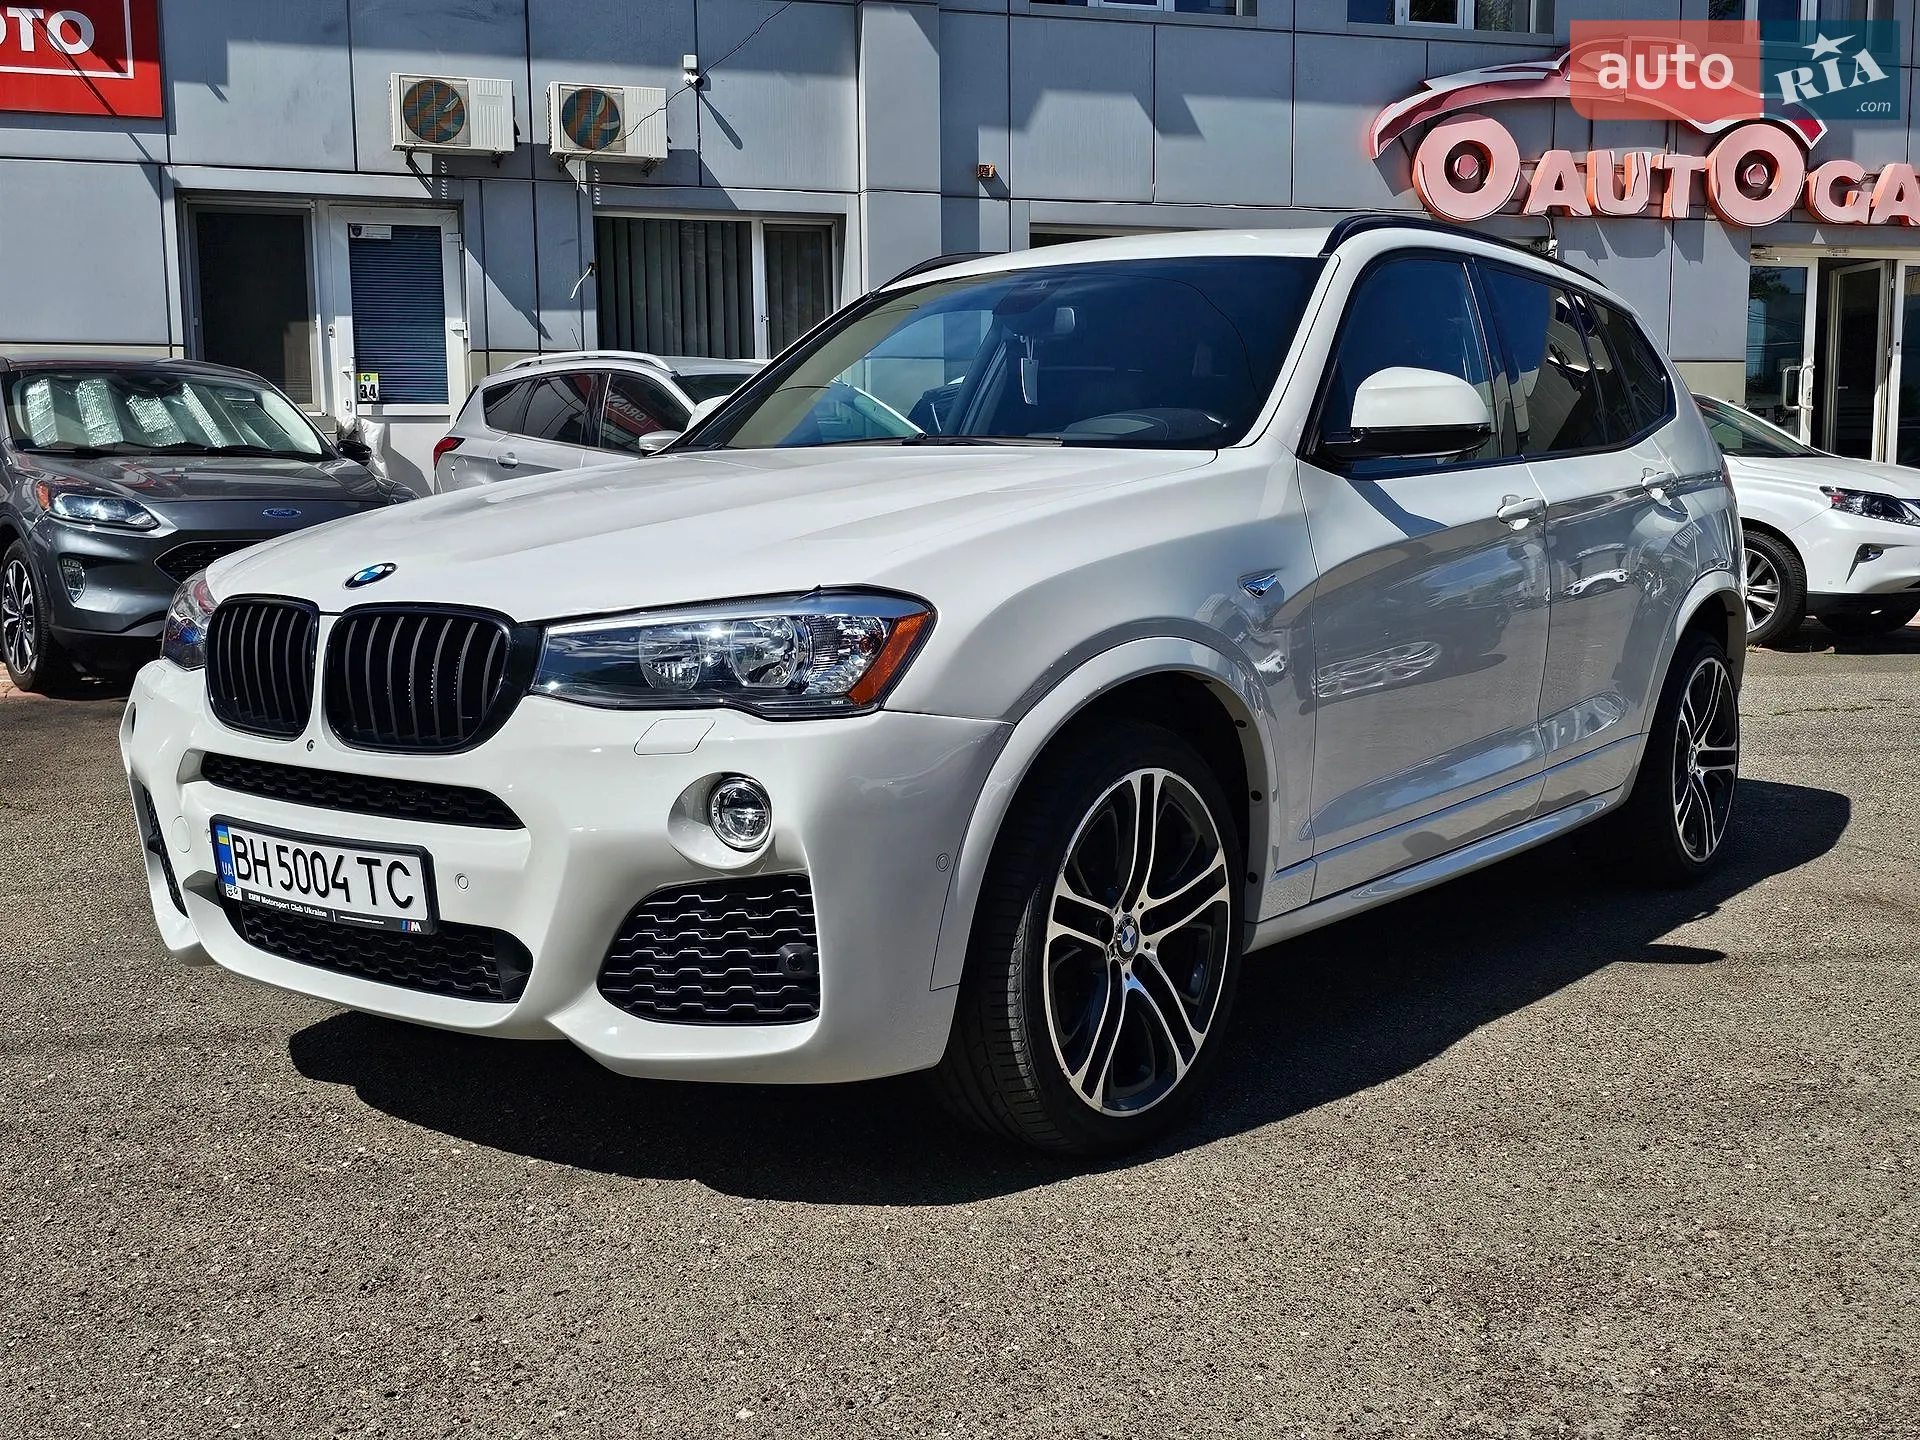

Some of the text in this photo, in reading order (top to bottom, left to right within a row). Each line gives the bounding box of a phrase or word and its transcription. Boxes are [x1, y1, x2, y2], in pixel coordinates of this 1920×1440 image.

[0, 6, 95, 55] TO
[359, 384, 377, 399] 34
[221, 860, 235, 877] UA
[231, 833, 414, 910] BH 5004 TC
